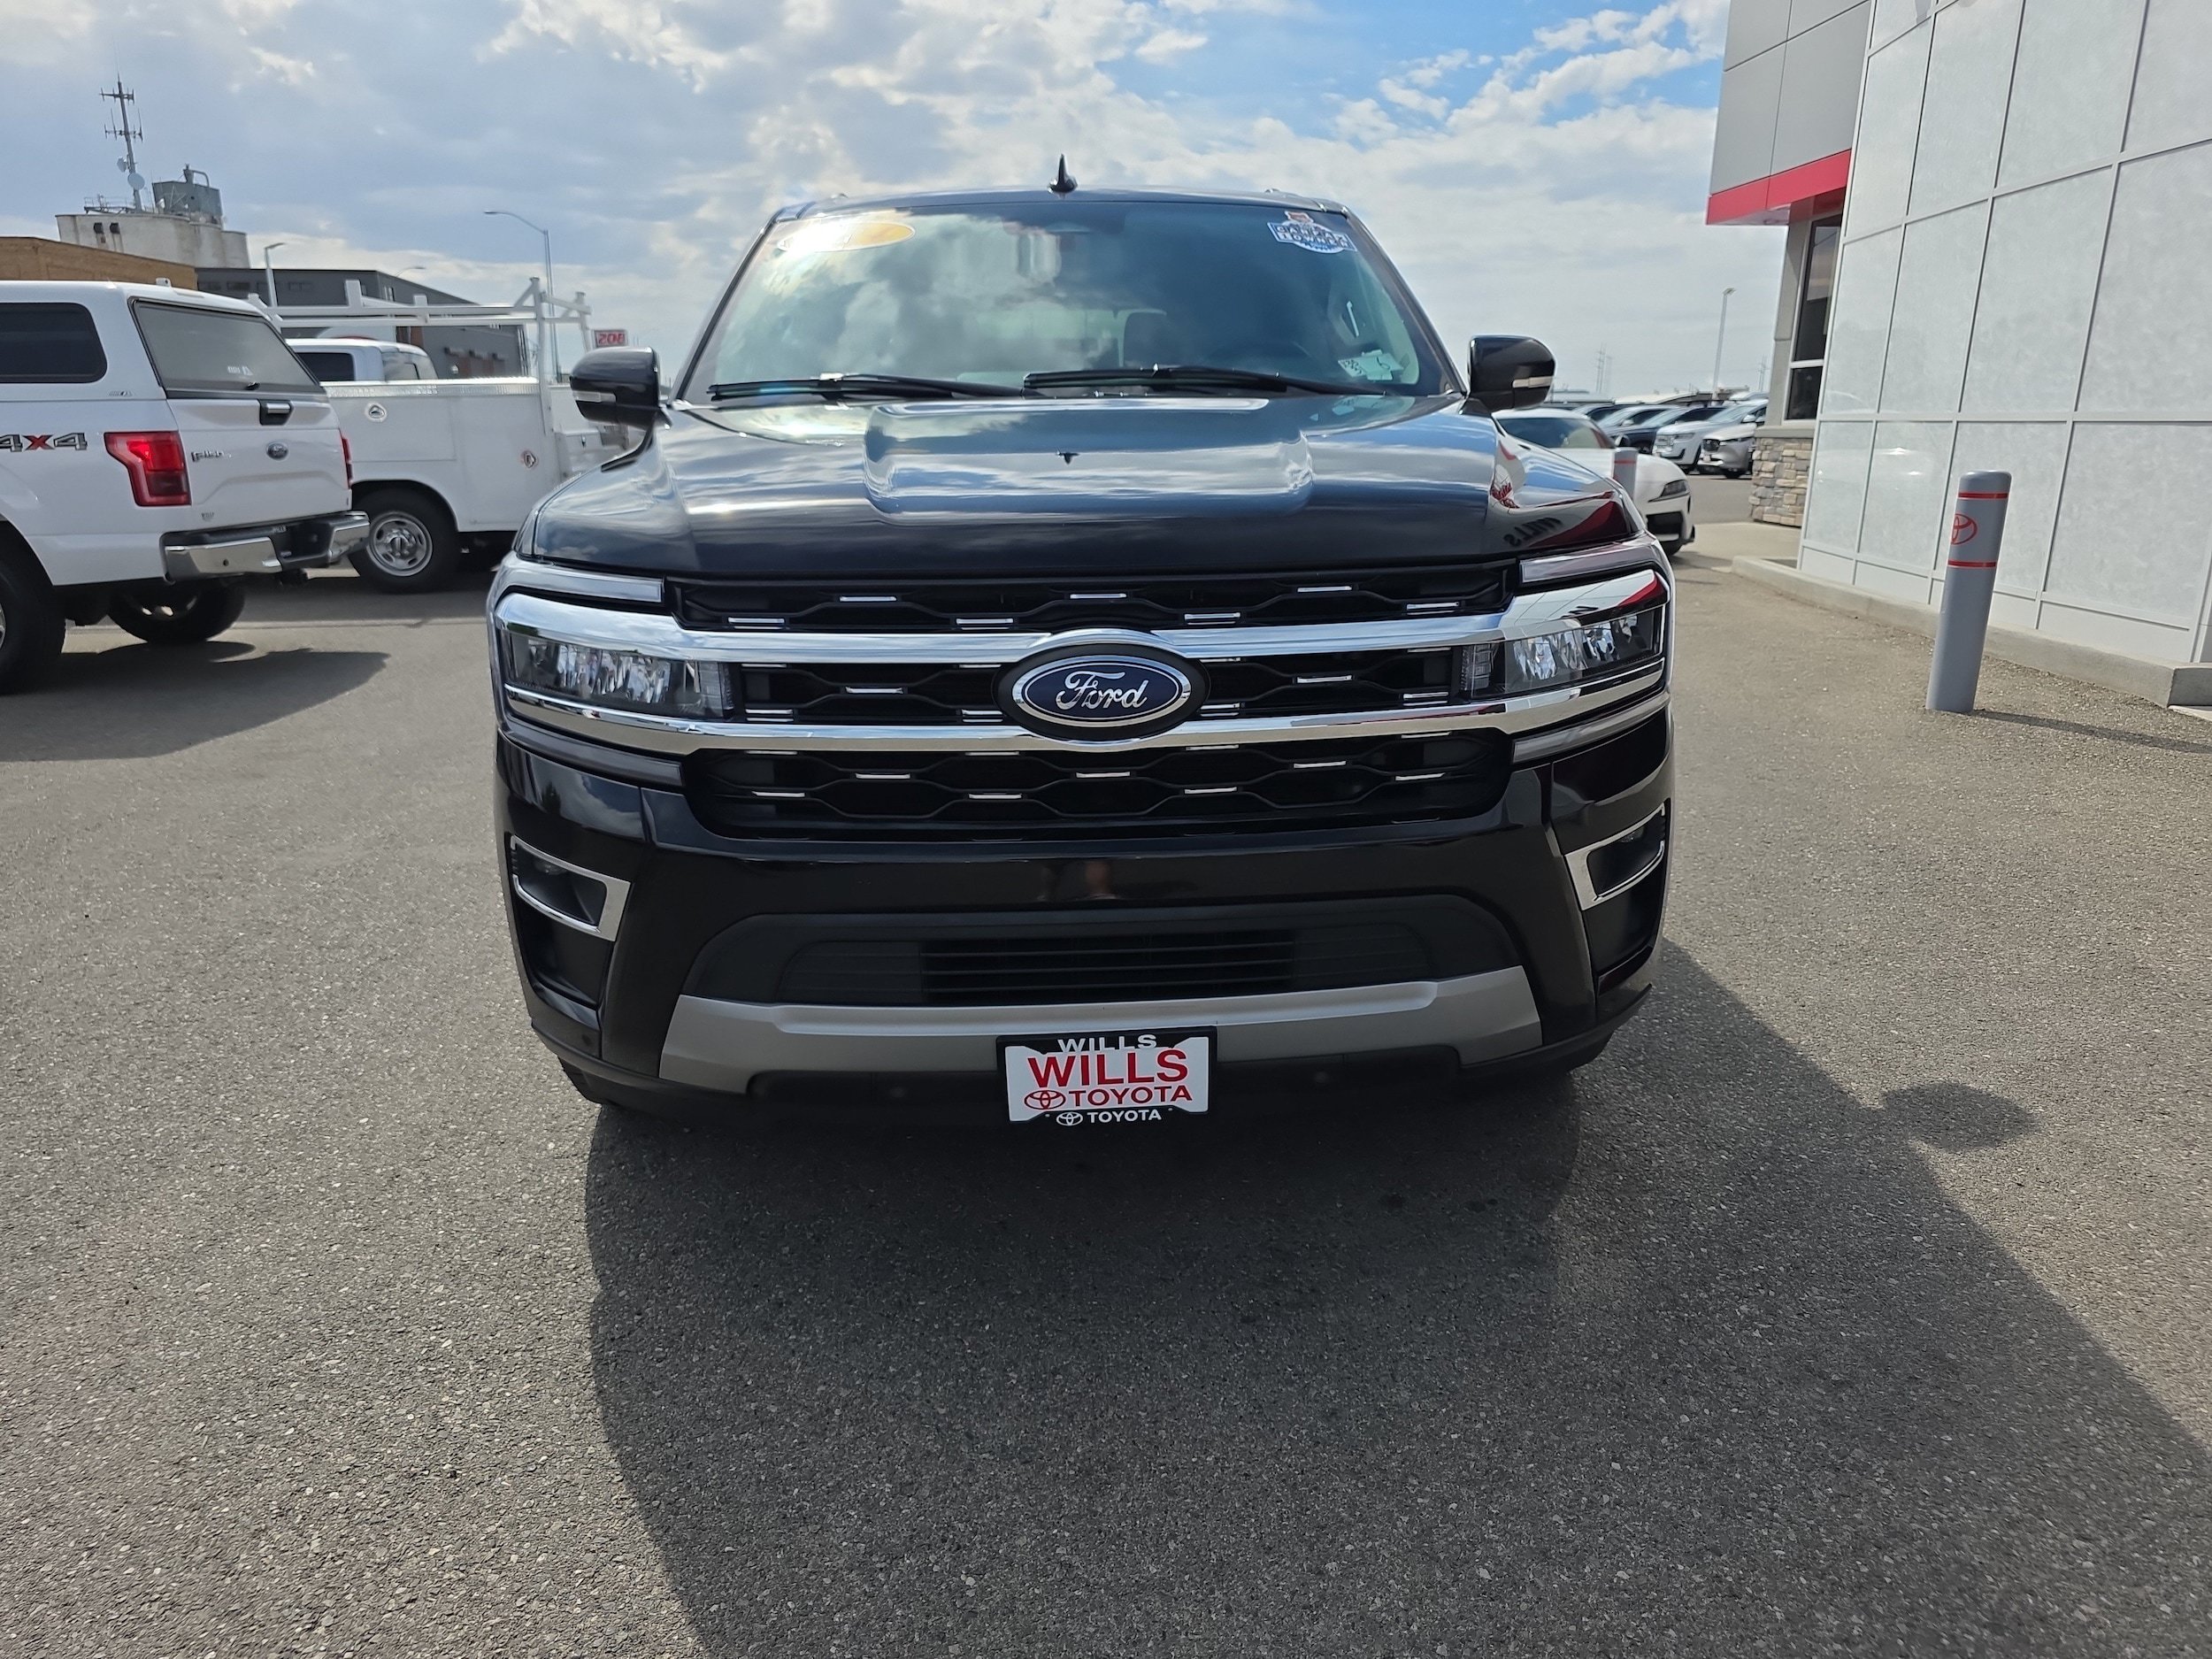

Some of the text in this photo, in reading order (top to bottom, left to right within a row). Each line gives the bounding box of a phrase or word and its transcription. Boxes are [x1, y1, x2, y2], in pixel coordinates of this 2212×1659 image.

[1056, 671, 1149, 709] Ford
[1057, 1033, 1157, 1053] WILLS
[1027, 1048, 1188, 1088] WILLS
[1068, 1085, 1192, 1107] TOYOTA
[1087, 1110, 1162, 1125] TOYOTA
